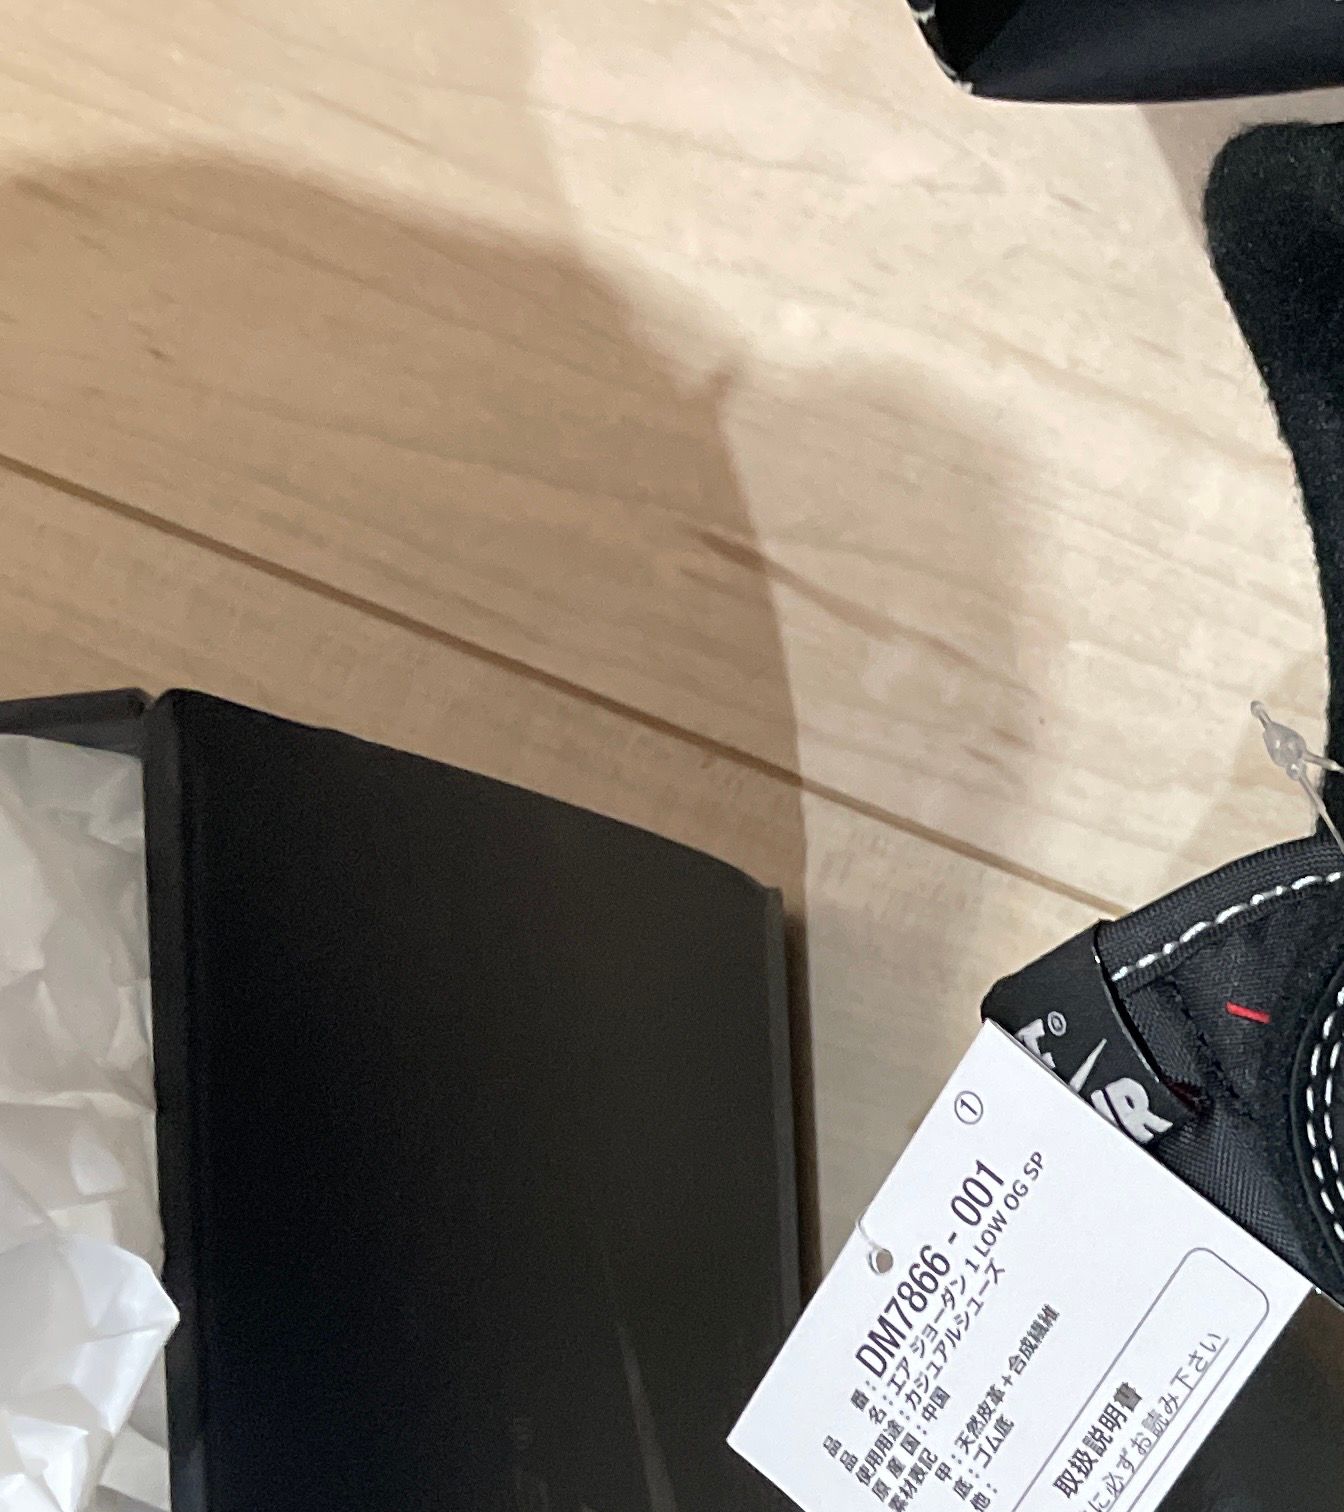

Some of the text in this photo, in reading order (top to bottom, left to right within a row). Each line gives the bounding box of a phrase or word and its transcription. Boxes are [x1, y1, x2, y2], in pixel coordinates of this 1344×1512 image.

[973, 1209, 1008, 1258] LOW
[1003, 1179, 1029, 1211] OG
[1023, 1151, 1043, 1181] SP
[1052, 1381, 1143, 1499] 取扱説明書
